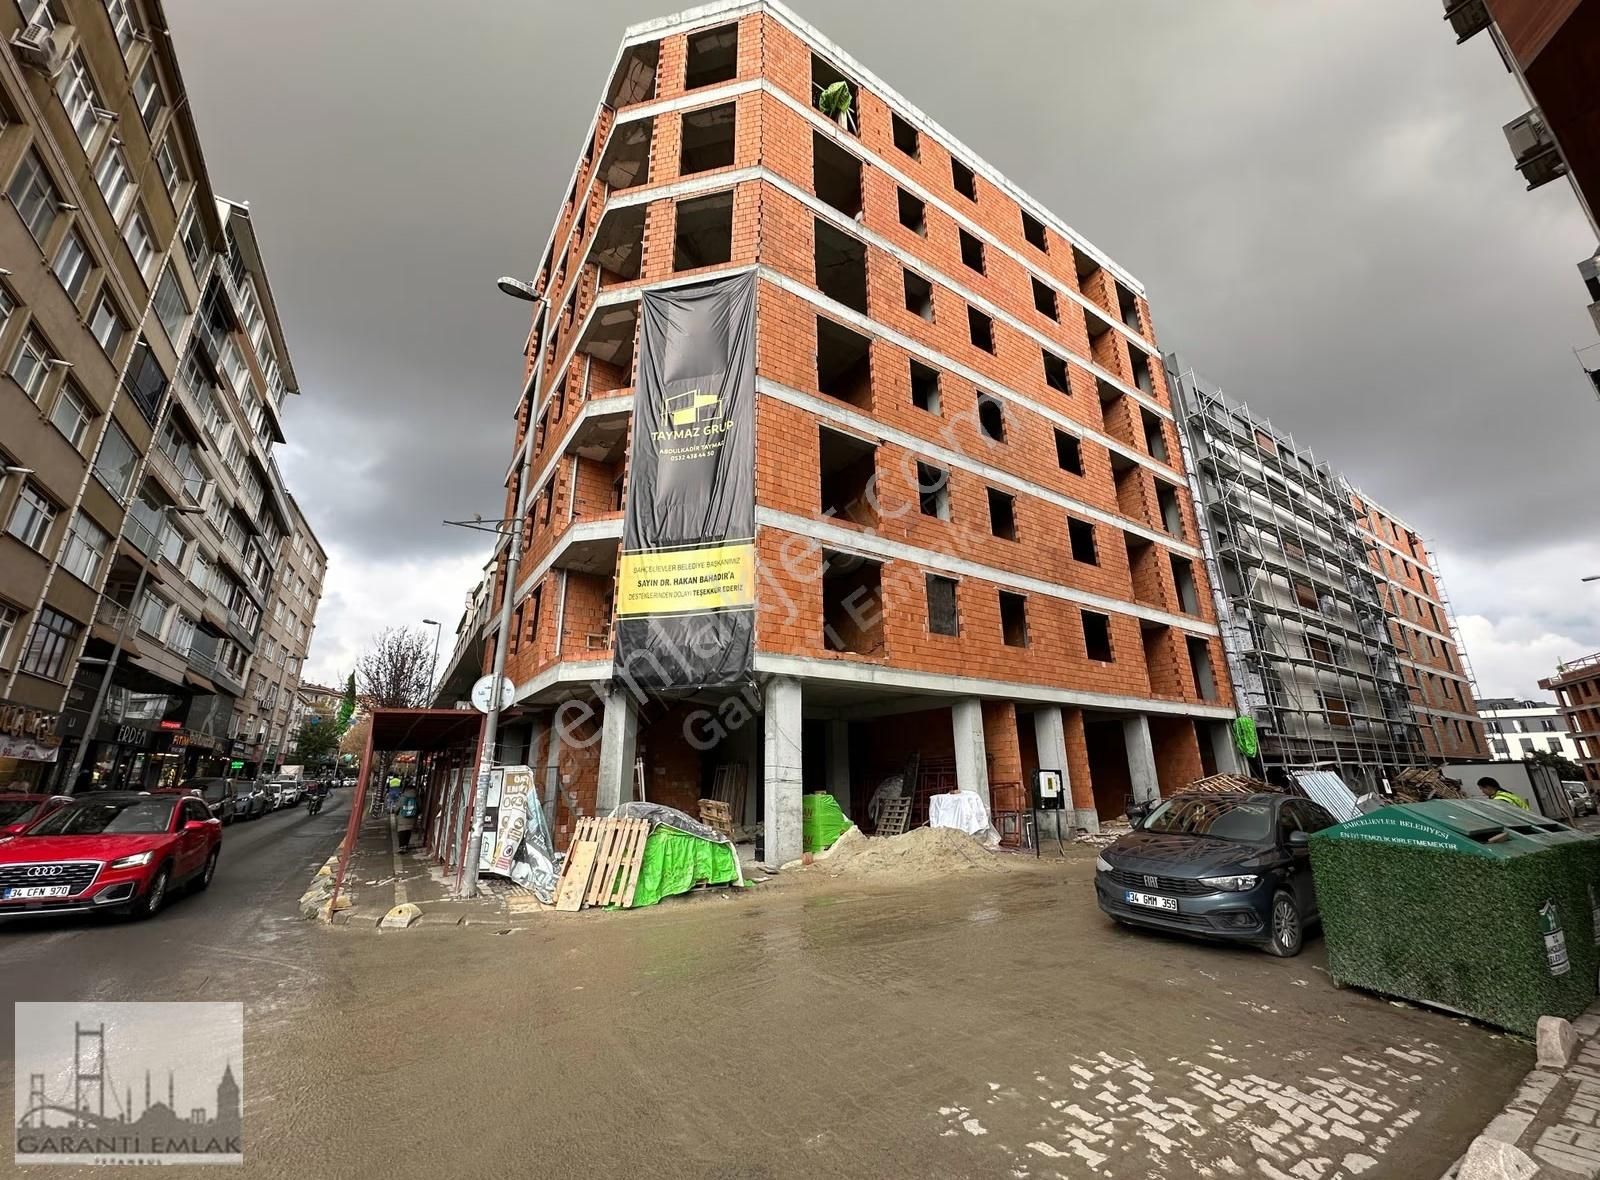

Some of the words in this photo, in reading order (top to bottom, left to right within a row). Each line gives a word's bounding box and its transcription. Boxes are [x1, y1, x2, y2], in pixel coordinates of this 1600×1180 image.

[651, 427, 700, 441] TAYMAZ
[703, 420, 734, 436] GRUP
[637, 578, 659, 588] SAYIN
[660, 578, 672, 587] DR.
[673, 576, 698, 586] HAKAN
[699, 571, 735, 584] BAHADIR'A
[693, 586, 722, 597] TEŞEKKÜR
[1143, 875, 1159, 888] FIAT
[11, 889, 22, 898] 34
[27, 887, 46, 897] CFN
[50, 886, 68, 896] 970
[1130, 892, 1139, 902] 34
[1143, 894, 1158, 906] GMM
[1162, 898, 1176, 910] 359
